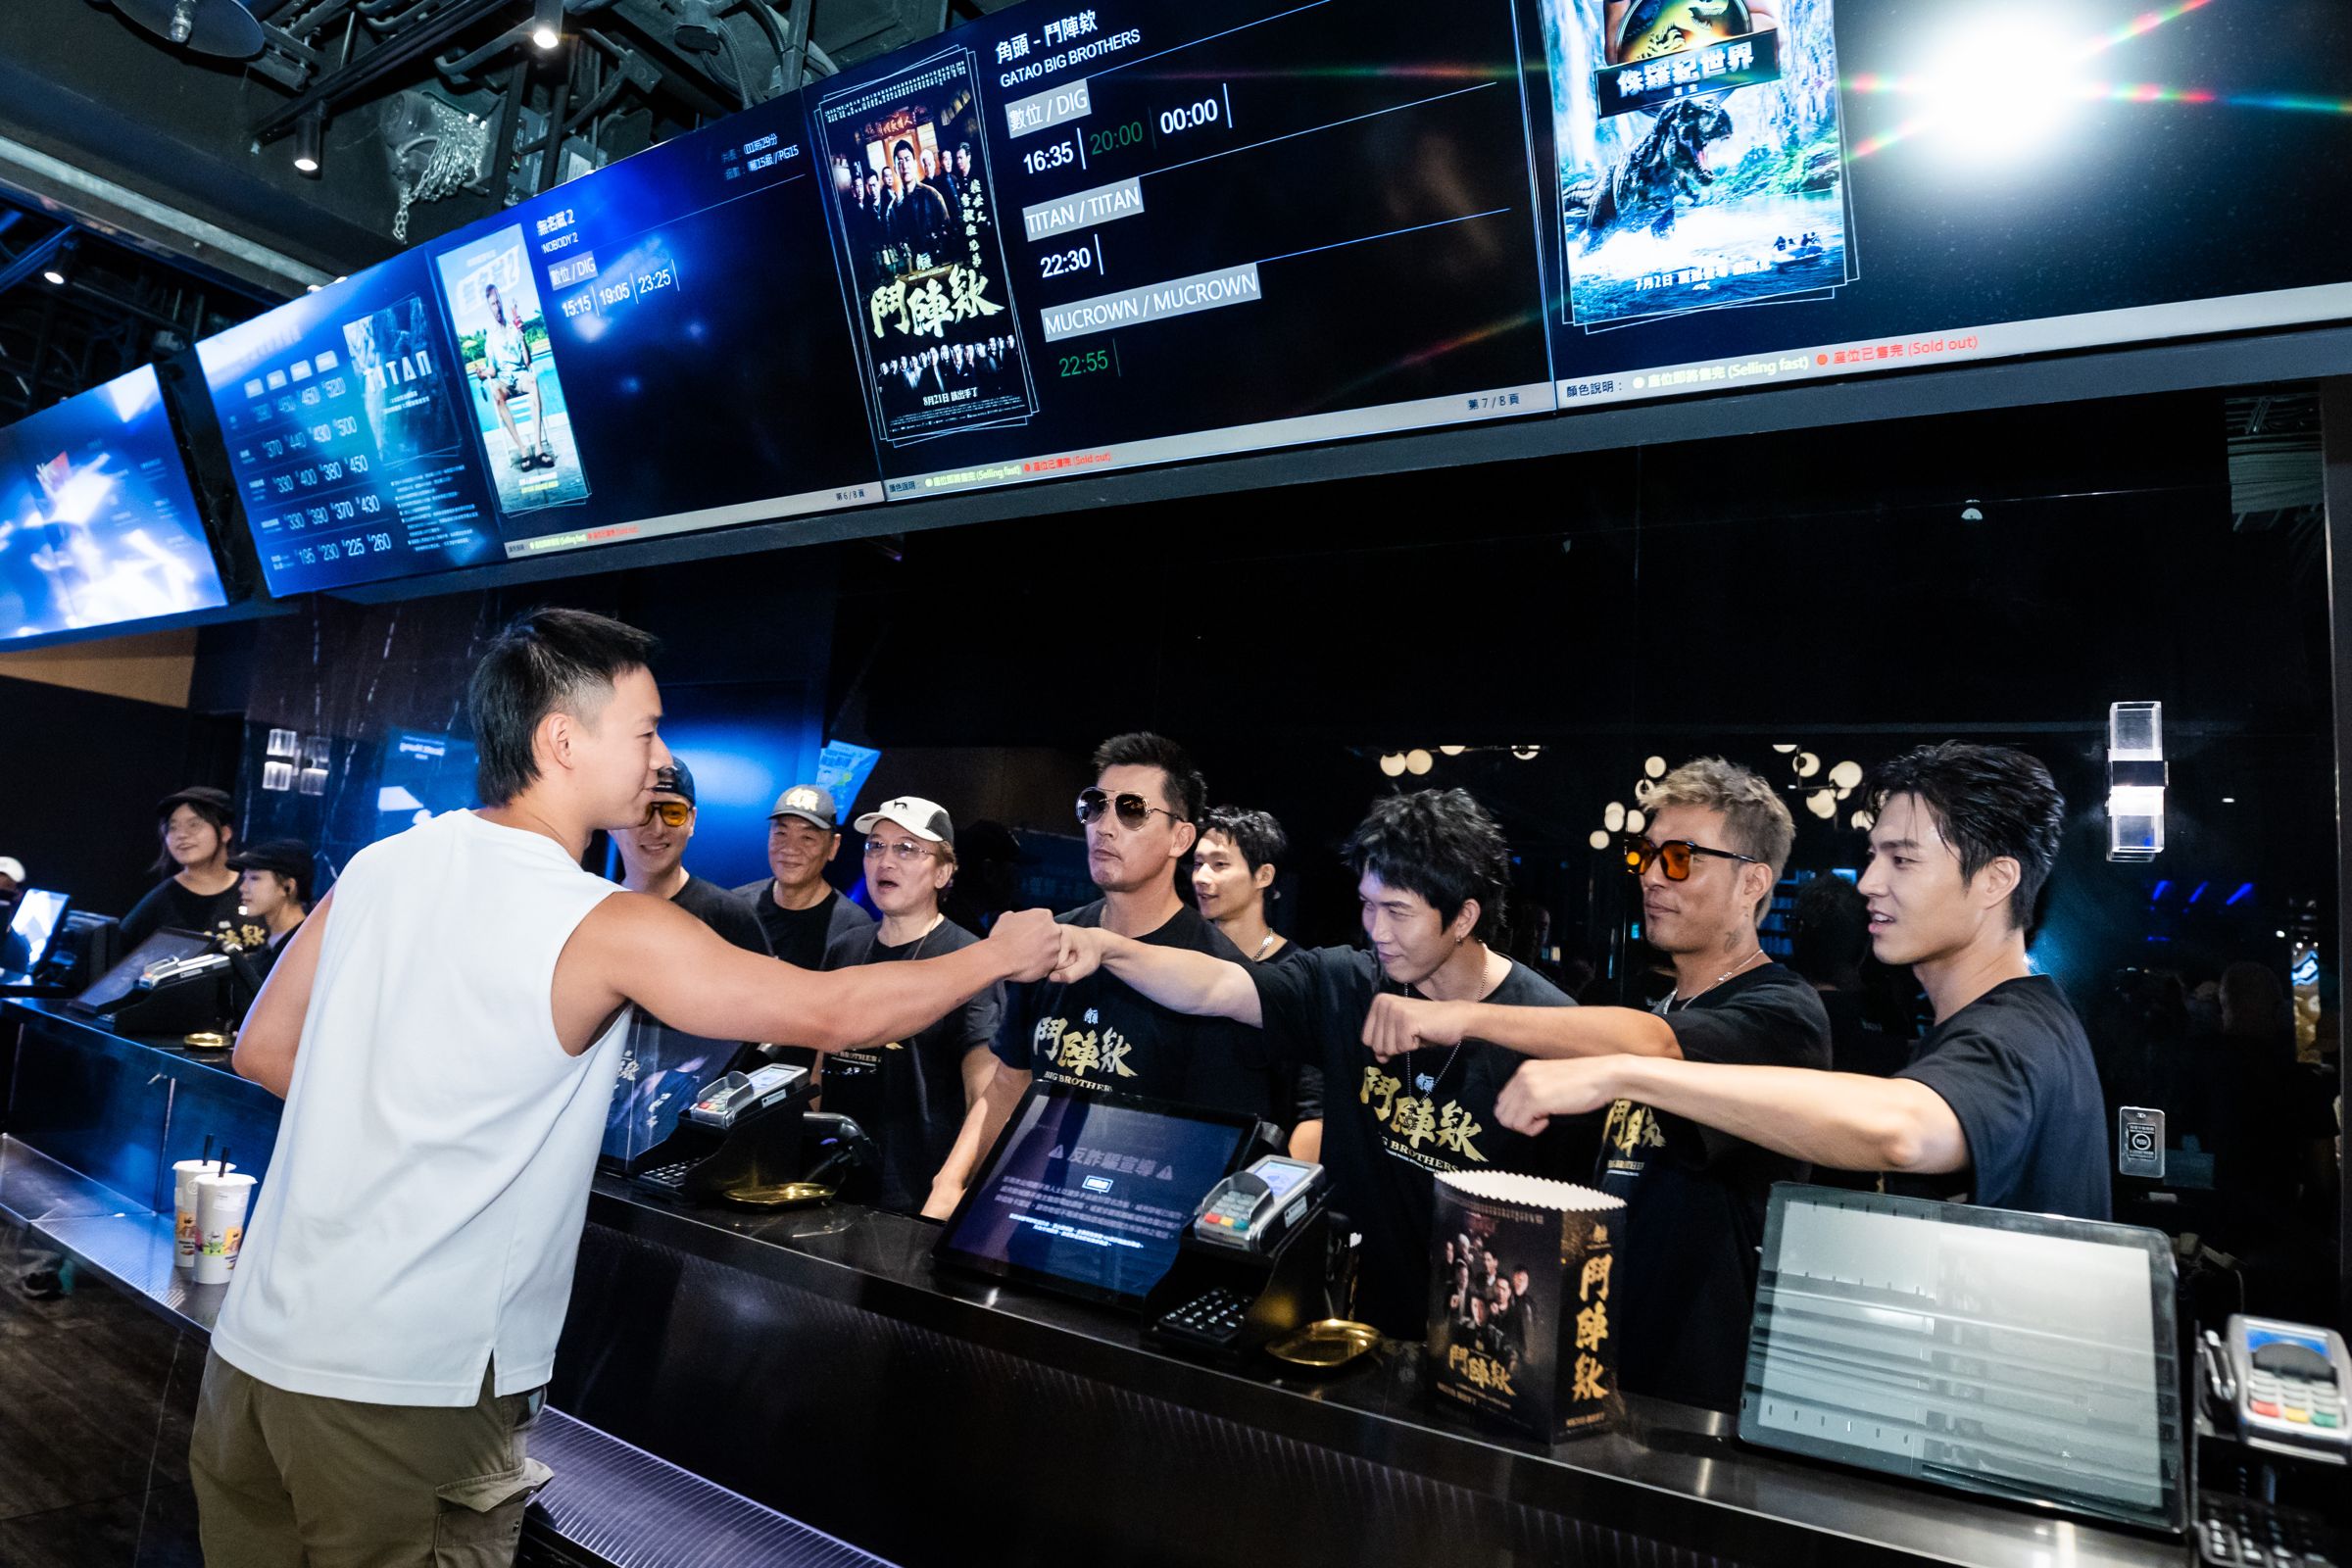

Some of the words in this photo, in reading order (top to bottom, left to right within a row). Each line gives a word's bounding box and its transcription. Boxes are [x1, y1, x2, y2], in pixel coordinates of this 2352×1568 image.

[996, 33, 1030, 64] 角頭
[1044, 9, 1098, 47] 鬥陣欸
[1001, 63, 1043, 88] GATAO
[1045, 55, 1067, 74] BIG
[1068, 29, 1141, 66] BROTHERS
[1617, 41, 1754, 98] 侏羅紀世界
[1009, 104, 1043, 132] 數位
[1056, 89, 1088, 117] DIG
[1023, 141, 1074, 173] 16:35
[1090, 122, 1143, 155] 20:00
[1160, 99, 1218, 134] 00:00
[1026, 203, 1075, 233] TITAN
[1088, 186, 1141, 218] TITAN
[541, 235, 572, 254] NOBODY
[577, 257, 596, 276] DIG
[1040, 247, 1092, 277] 22:30
[562, 295, 592, 318] 15:15
[599, 282, 630, 306] 19:05
[638, 269, 671, 294] 23:25
[870, 264, 1005, 338] 鬥陣欸
[1045, 298, 1139, 334] MUCROWN
[1153, 272, 1256, 312] MUCROWN
[1059, 350, 1108, 377] 22:55
[1728, 362, 1776, 379] (Selling
[1779, 356, 1808, 370] fast)
[1834, 344, 1903, 365] 座位已售完
[1908, 339, 1943, 357] (Sold
[1948, 335, 1978, 350] out)
[1033, 1016, 1139, 1077] 鬥陣欸
[1044, 1070, 1058, 1081] BIG
[1390, 1140, 1459, 1172] BROTHERS
